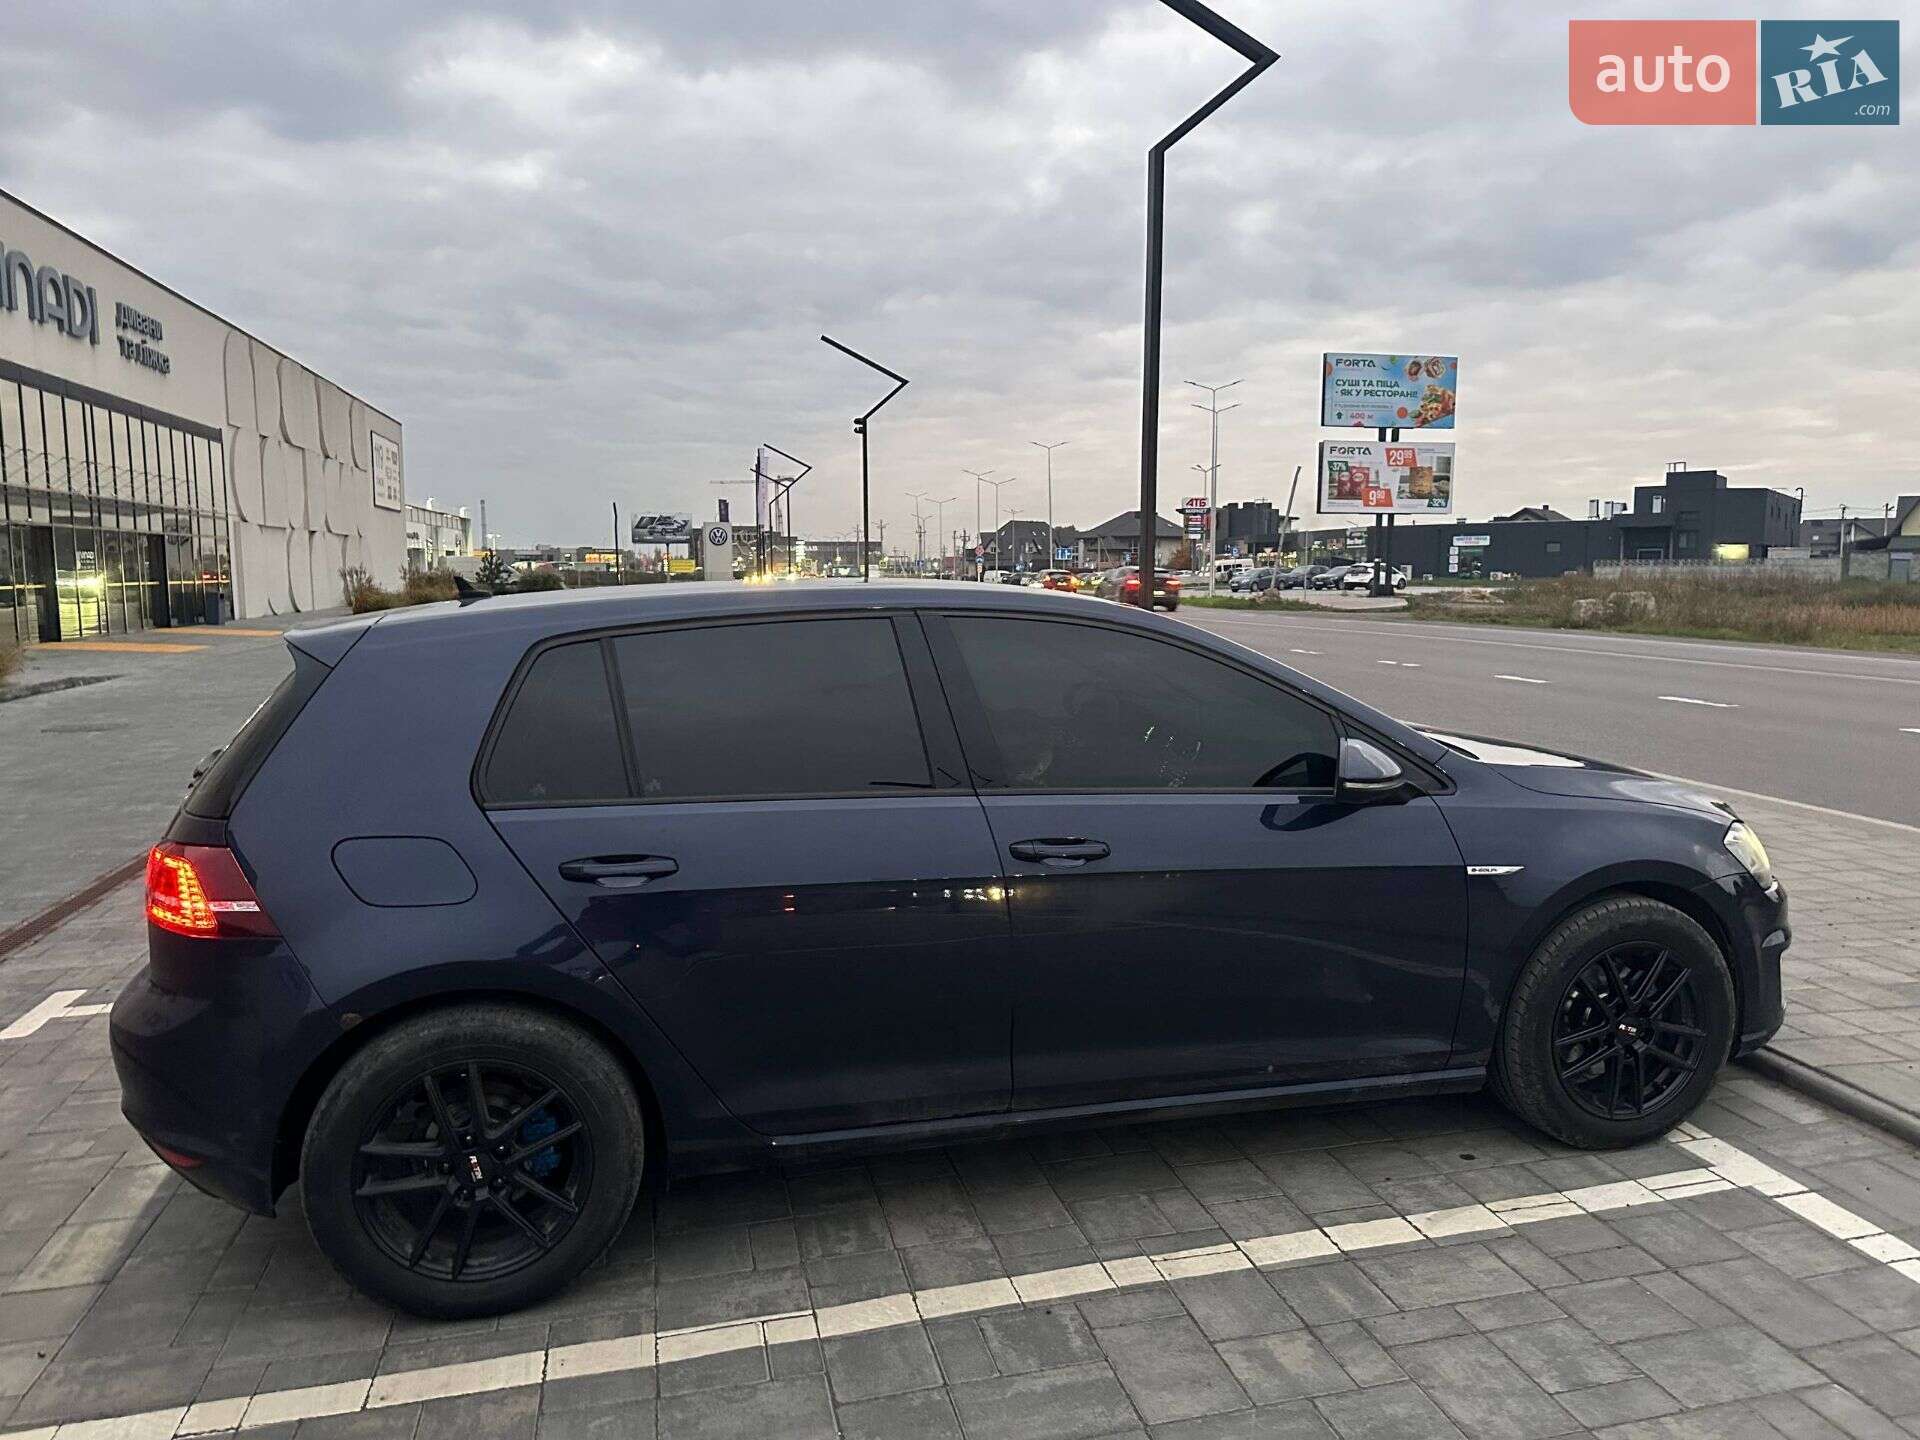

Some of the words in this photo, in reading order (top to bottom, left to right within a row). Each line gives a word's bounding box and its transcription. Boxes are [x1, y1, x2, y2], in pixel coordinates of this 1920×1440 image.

[1335, 358, 1376, 368] FORTA
[1335, 379, 1360, 387] СУШІ
[1362, 379, 1375, 387] ТА
[1376, 380, 1400, 388] ПІЦА
[1340, 389, 1354, 397] ЯК
[1353, 389, 1362, 397] У
[1329, 446, 1372, 456] FORTA
